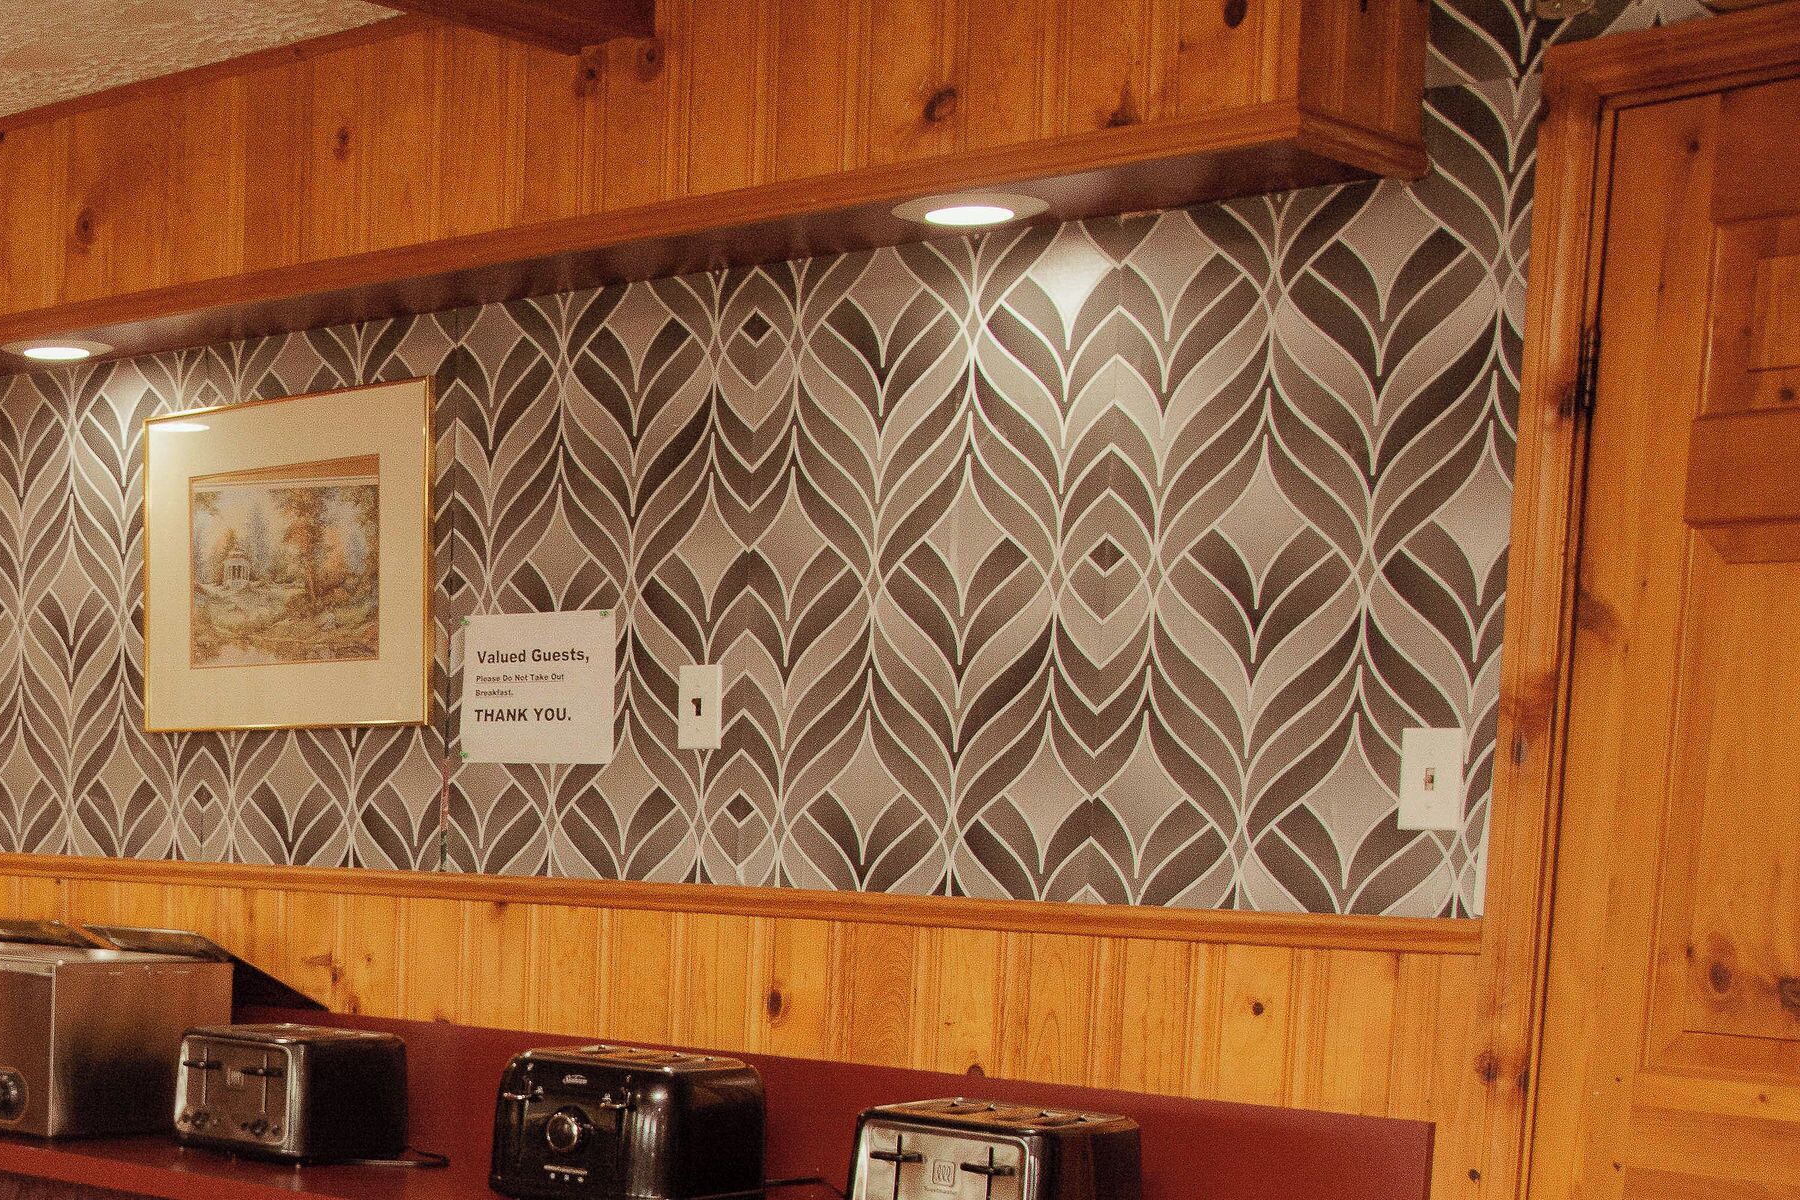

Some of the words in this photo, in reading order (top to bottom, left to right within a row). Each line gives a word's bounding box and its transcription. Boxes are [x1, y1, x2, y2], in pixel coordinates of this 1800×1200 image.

[477, 649, 526, 664] Valued
[531, 647, 590, 664] Guests,
[502, 674, 513, 682] Do
[514, 674, 528, 682] Not
[530, 673, 548, 681] Take
[550, 673, 564, 681] Out
[475, 689, 514, 697] Breakfast.
[474, 708, 528, 722] THANK
[533, 707, 572, 722] YOU.
